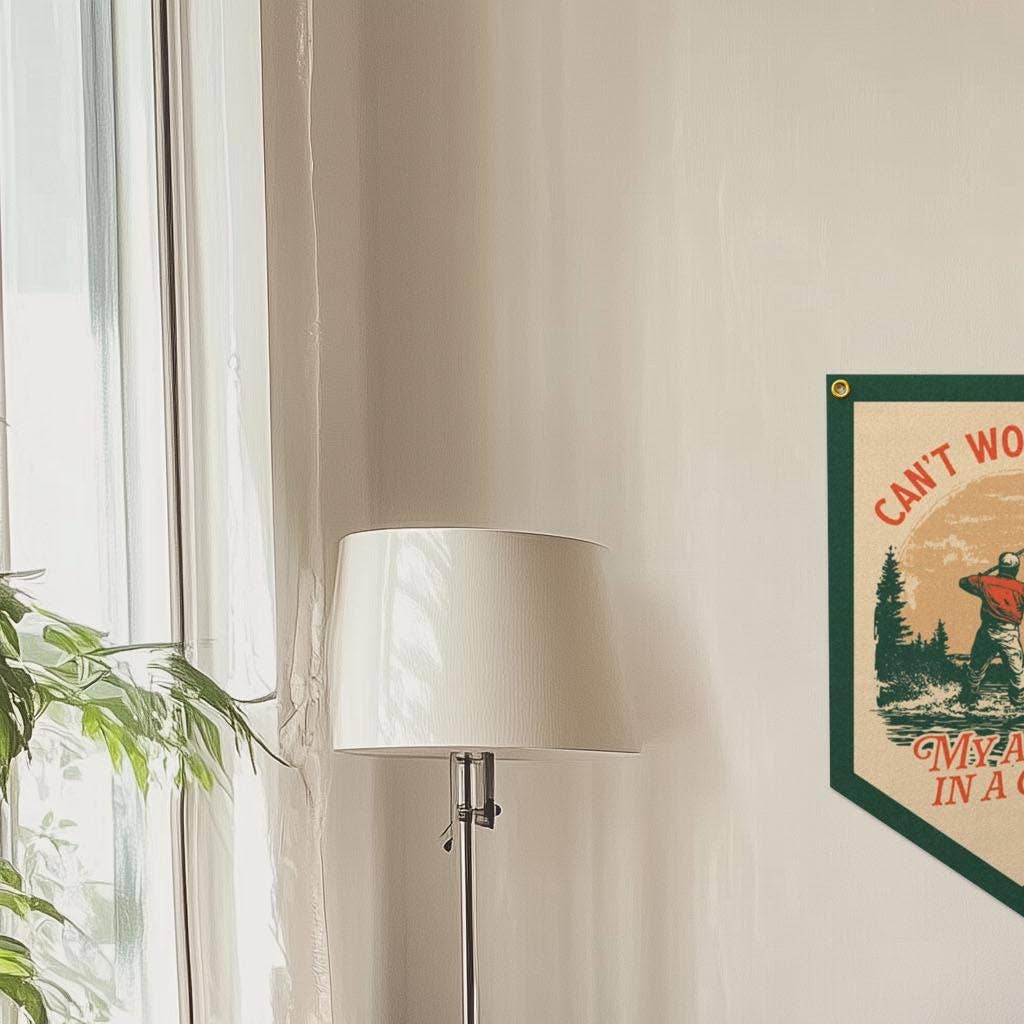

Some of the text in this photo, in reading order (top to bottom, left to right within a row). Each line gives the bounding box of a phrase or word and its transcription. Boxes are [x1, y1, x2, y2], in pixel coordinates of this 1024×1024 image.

[874, 442, 957, 527] CAN'T
[913, 732, 998, 772] MY
[931, 773, 977, 807] IN
[980, 770, 1007, 802] A
